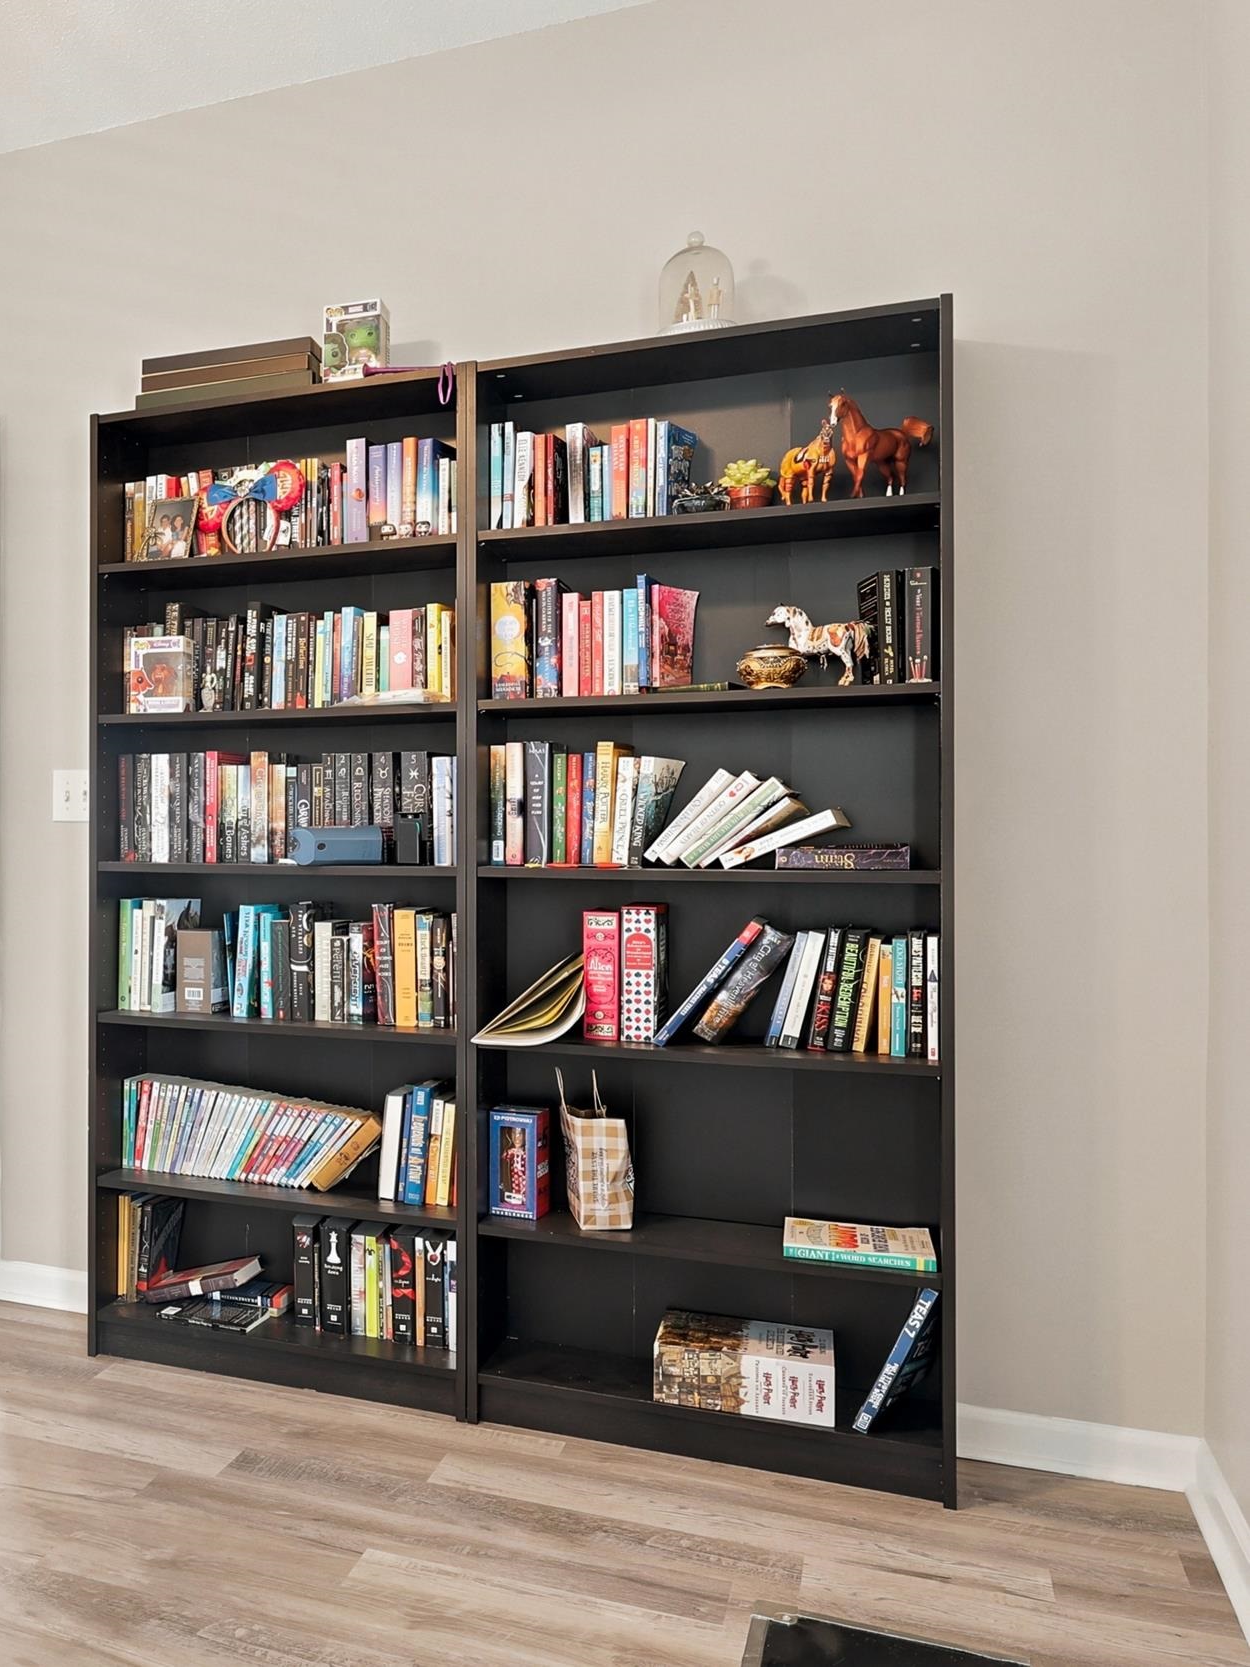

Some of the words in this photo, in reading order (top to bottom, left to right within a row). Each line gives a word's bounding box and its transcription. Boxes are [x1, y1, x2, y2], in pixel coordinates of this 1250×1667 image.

[517, 454, 527, 482] KENNEDY
[298, 637, 307, 669] Reflection
[356, 755, 363, 763] 3
[410, 754, 417, 764] 5
[599, 761, 610, 788] HARRY
[372, 787, 383, 824] PRINCESS
[382, 787, 392, 824] SHADOW
[599, 792, 610, 825] POTTER
[619, 793, 628, 820] CRUEL
[635, 793, 647, 825] WICKED
[225, 830, 233, 859] Bones
[241, 828, 250, 856] Ashes
[616, 822, 628, 850] PRINCE
[632, 825, 644, 848] KING
[815, 853, 856, 870] Stain
[419, 933, 428, 951] Black
[751, 942, 772, 964] City
[419, 952, 428, 976] Beauty
[705, 962, 725, 985] TEAS
[843, 943, 859, 981] BEAUTIFUL
[351, 951, 361, 1009] DIVERGENT
[720, 969, 754, 1009] Heavenly
[711, 1006, 728, 1025] Fire
[814, 1001, 830, 1031] KISS
[834, 982, 856, 1028] REDEMPTION
[410, 1114, 428, 1148] Legends
[408, 1156, 425, 1184] Arthur
[797, 1247, 830, 1261] GIANT
[840, 1252, 866, 1263] WORD
[867, 1256, 911, 1268] SEARCHES
[908, 1299, 932, 1329] TEAS
[904, 1327, 917, 1338] 7
